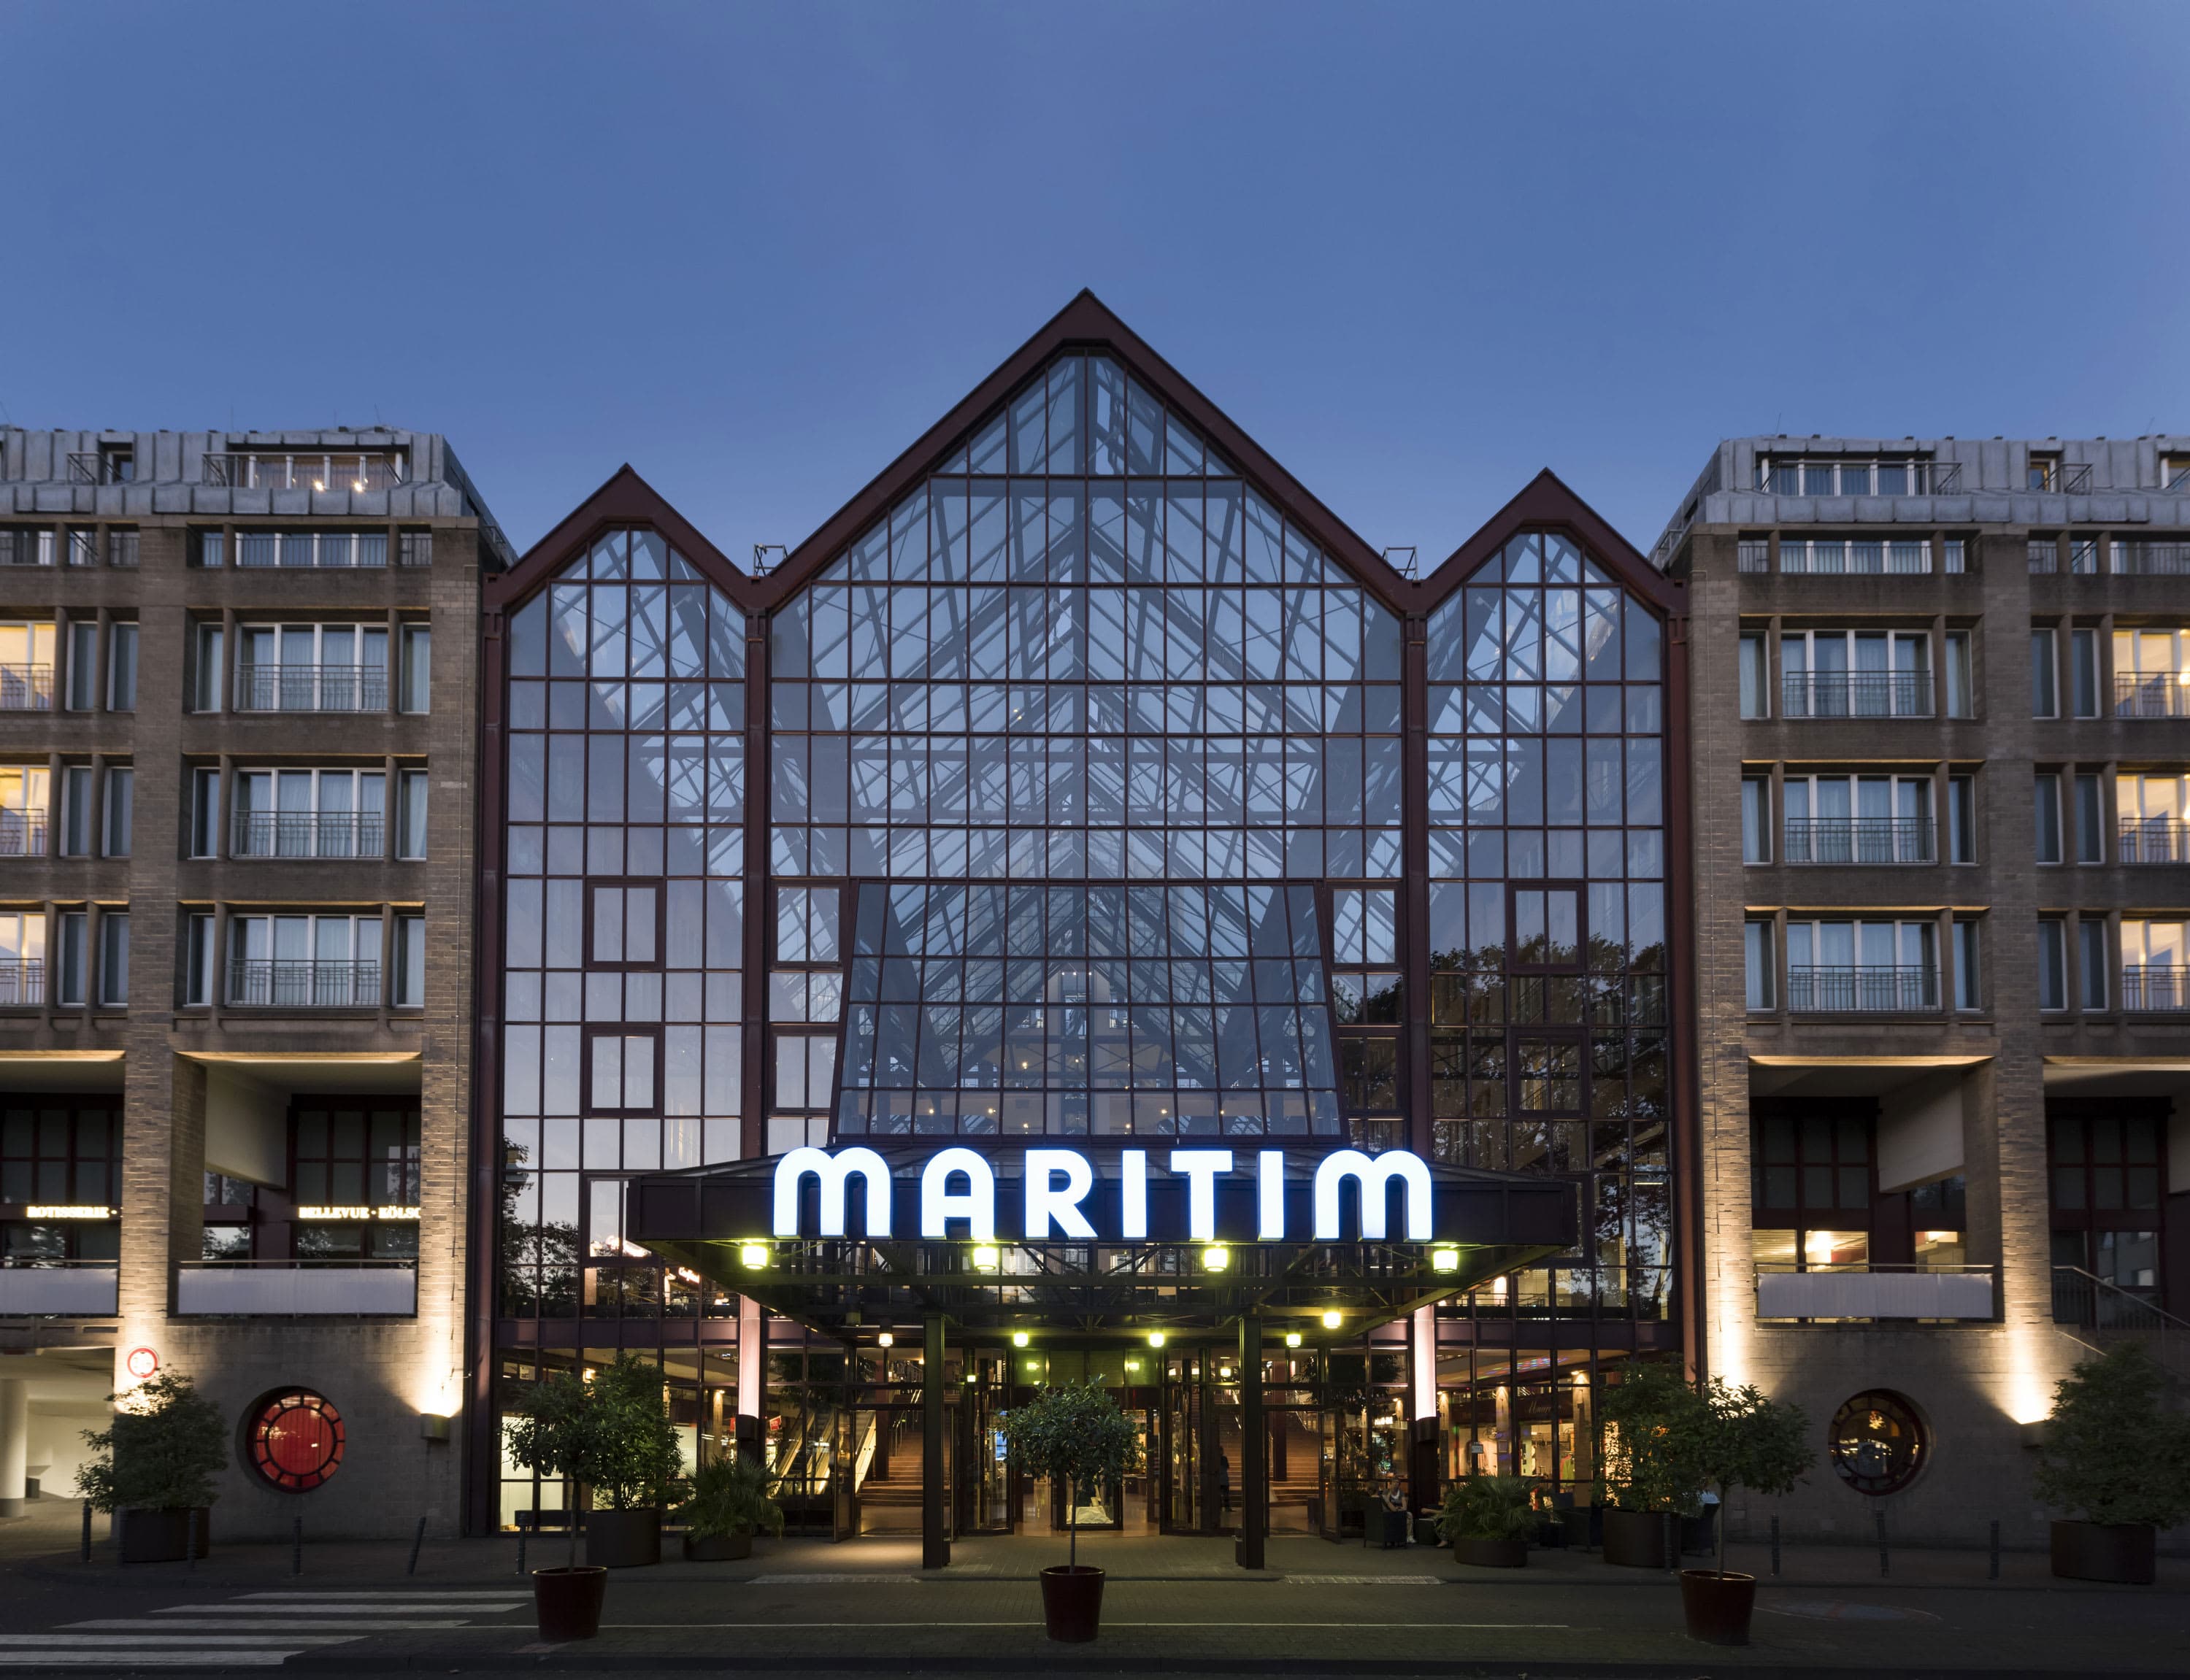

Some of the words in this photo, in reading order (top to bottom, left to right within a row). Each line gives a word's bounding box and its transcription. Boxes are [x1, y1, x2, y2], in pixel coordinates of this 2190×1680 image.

[772, 1147, 1433, 1242] MARITIM
[26, 1206, 110, 1218] ROTISSERIE
[299, 1206, 369, 1219] BELLEVUE
